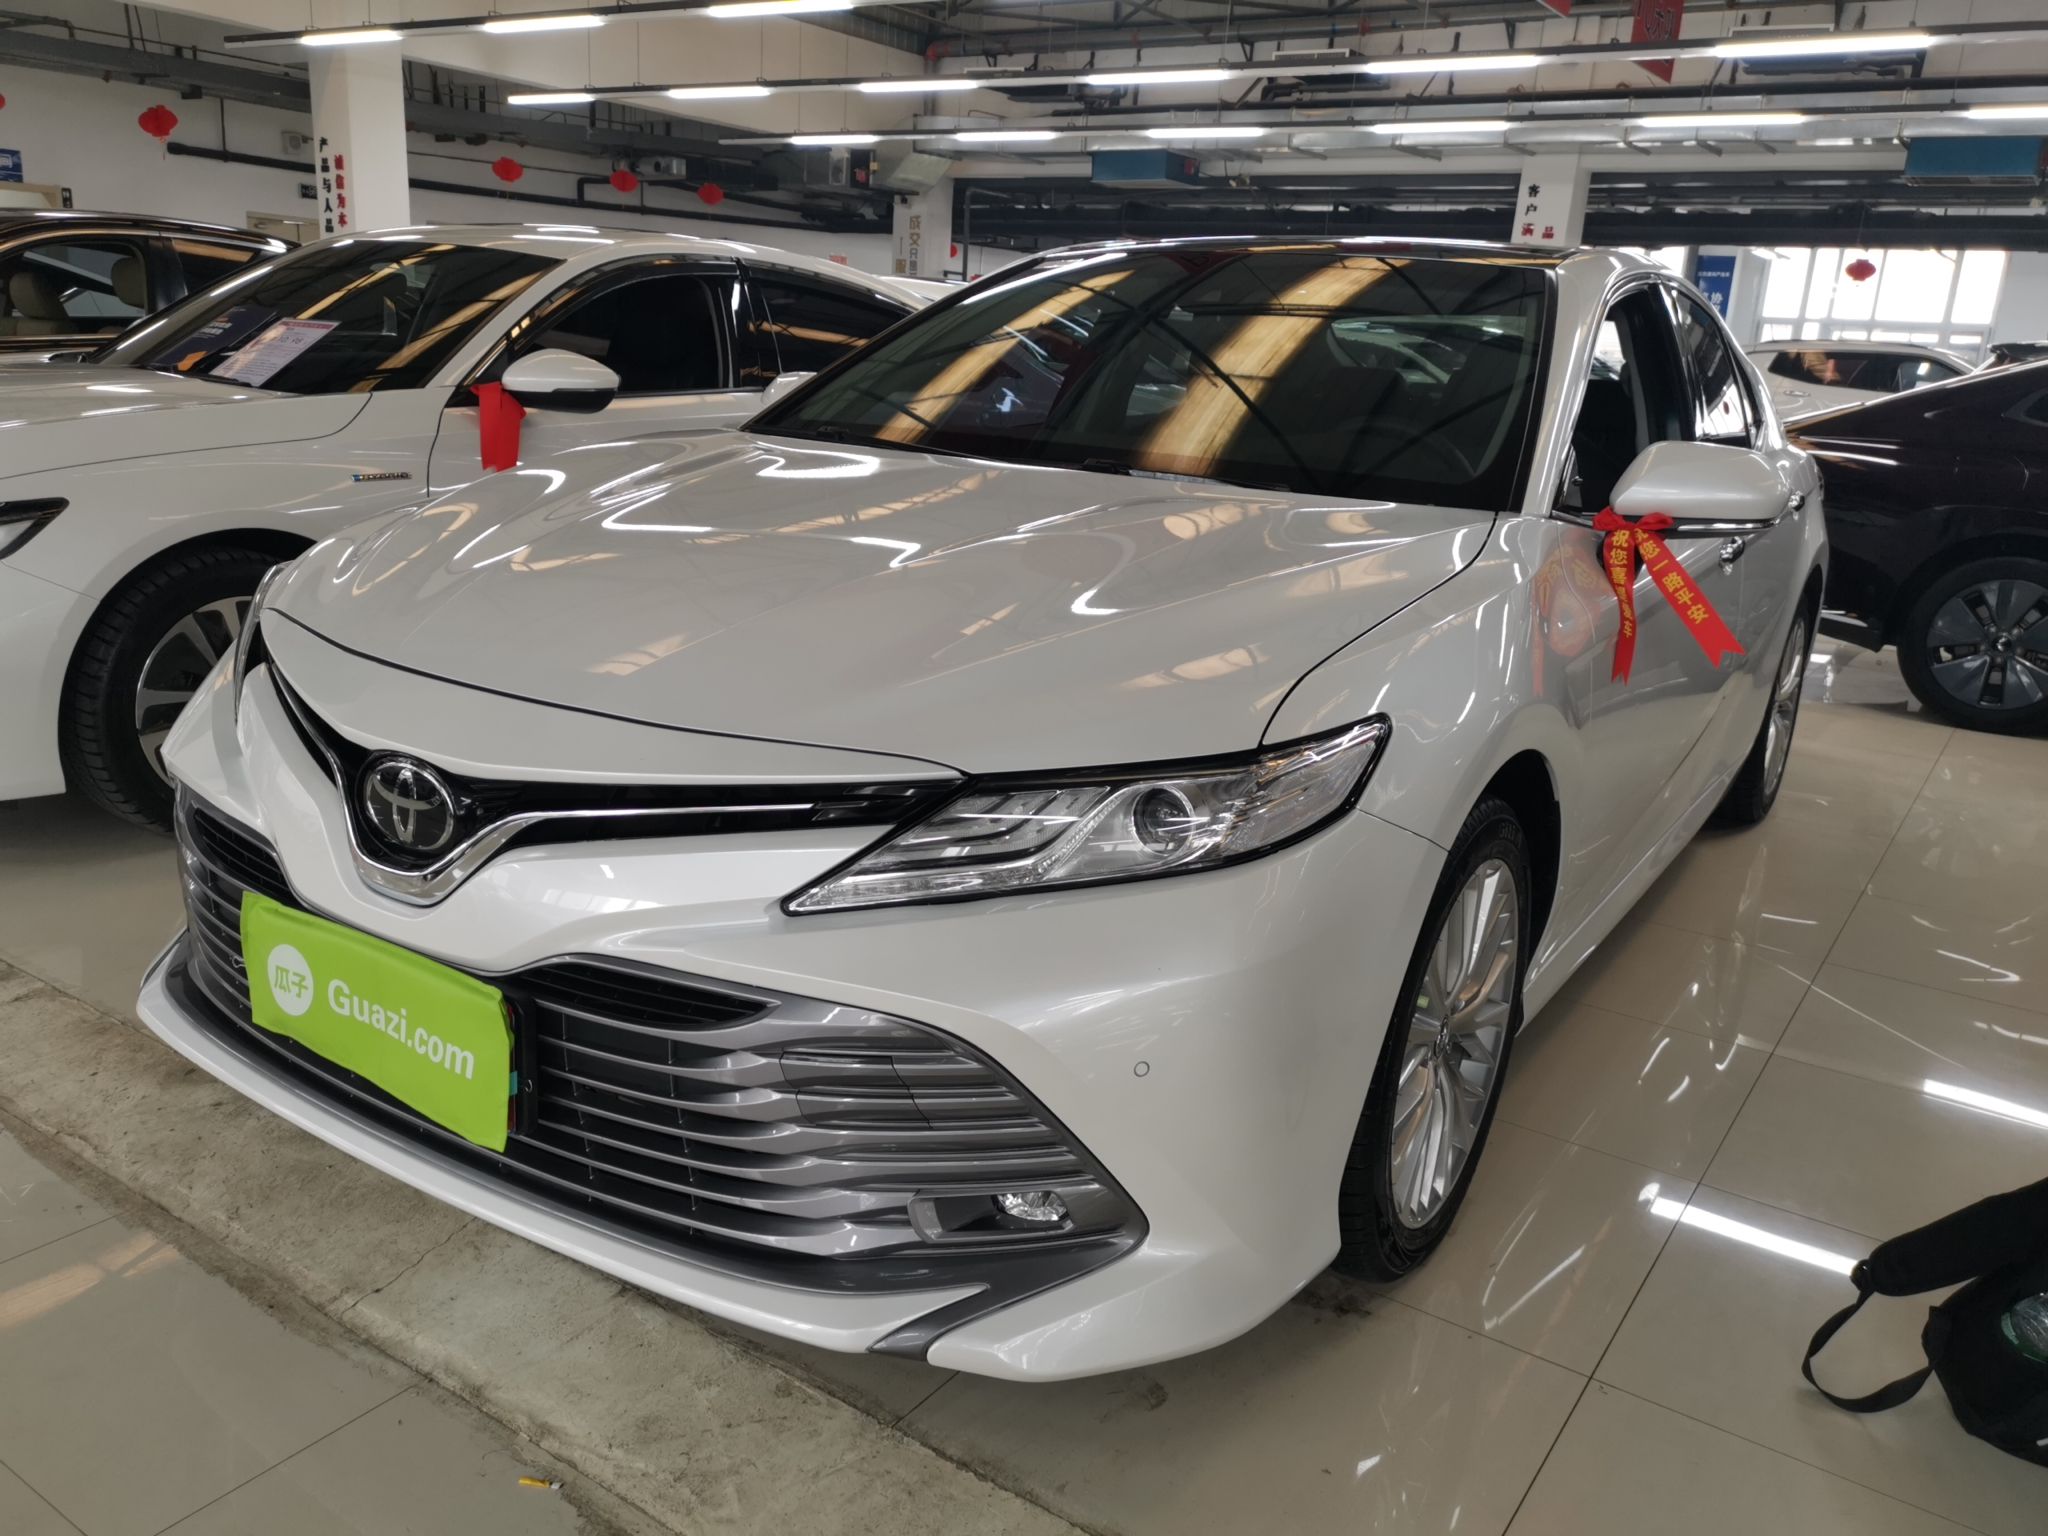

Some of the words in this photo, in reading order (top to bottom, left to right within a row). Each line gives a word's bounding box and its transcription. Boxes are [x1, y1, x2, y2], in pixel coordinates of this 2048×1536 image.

[319, 136, 334, 233] 产品与人品
[273, 965, 309, 999] 瓜子
[327, 978, 476, 1081] Guazi.com
